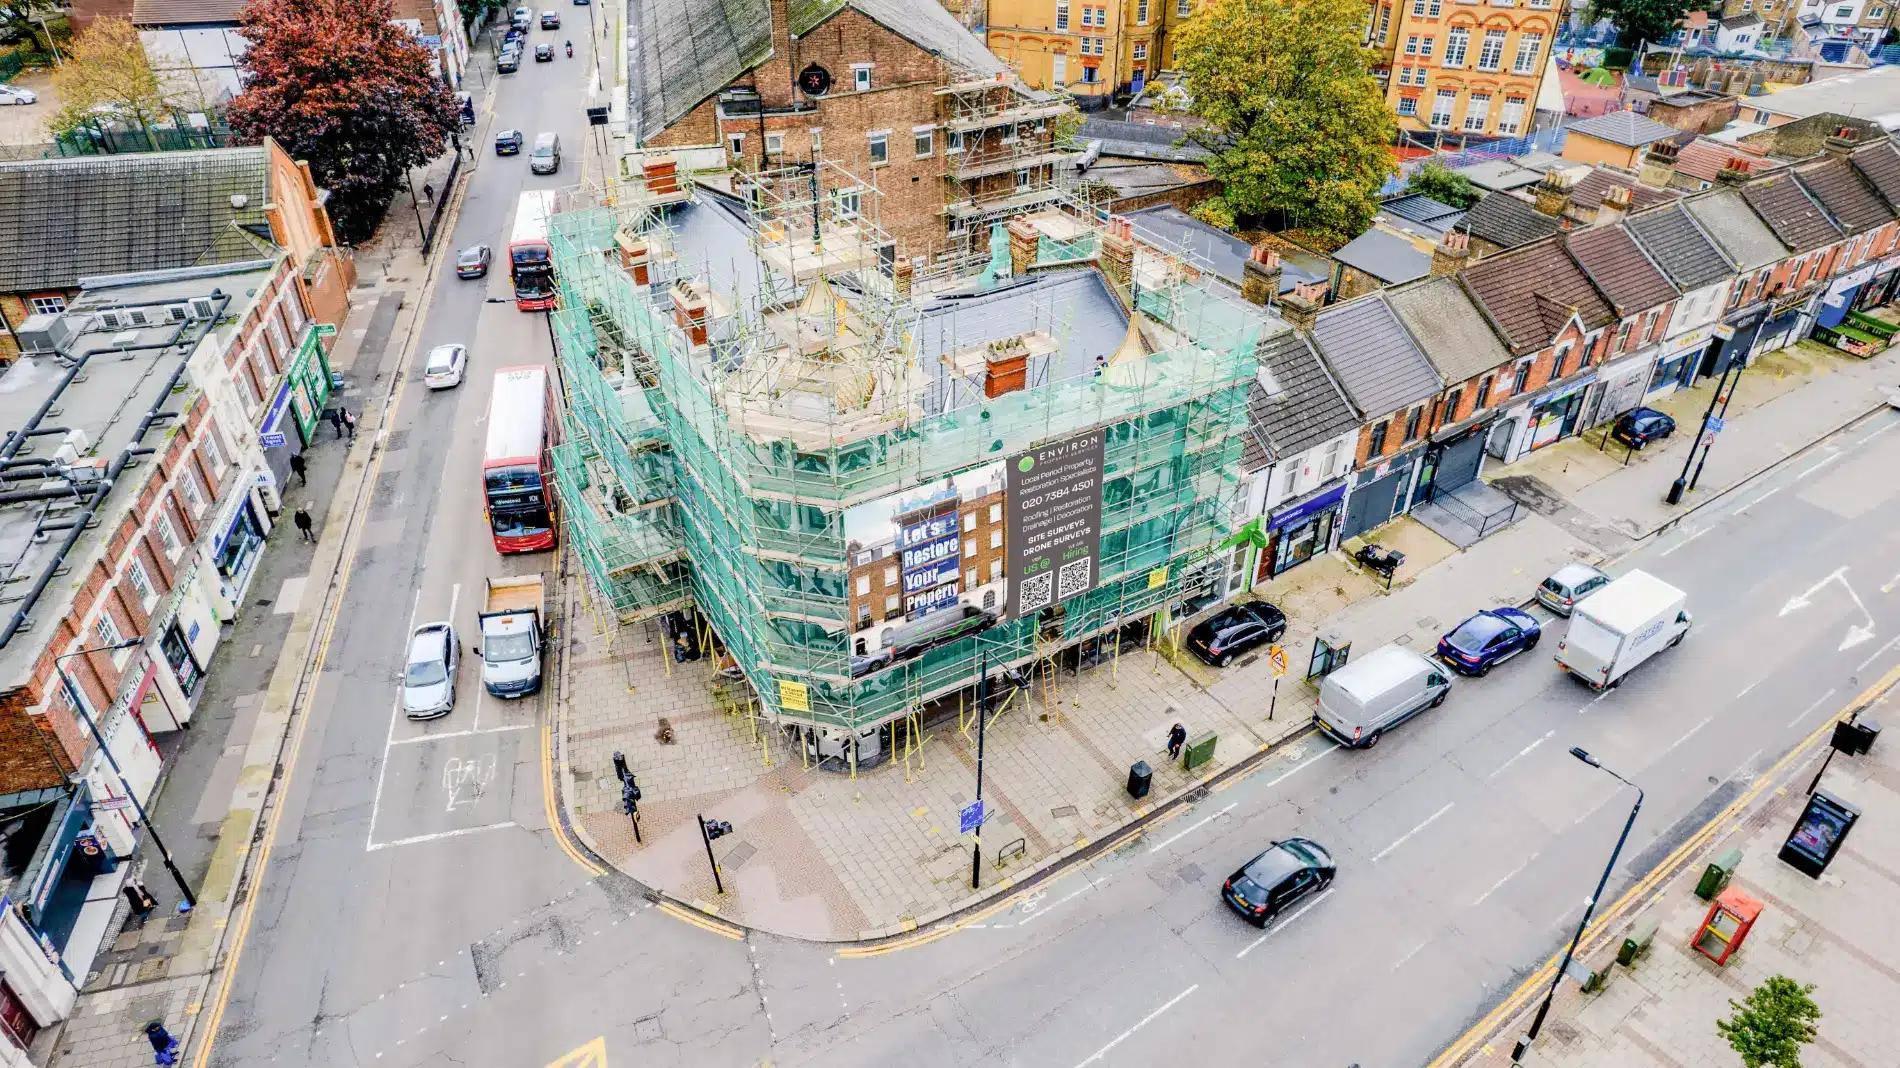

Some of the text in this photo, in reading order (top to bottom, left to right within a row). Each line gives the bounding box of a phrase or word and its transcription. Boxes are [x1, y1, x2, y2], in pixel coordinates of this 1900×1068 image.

[1039, 436, 1098, 461] ENVIRON
[1019, 466, 1097, 496] Restoration Specialists
[1021, 457, 1094, 486] Local Period Property
[1021, 478, 1094, 510] 020 7384 4501
[1022, 495, 1091, 523] Roofing Restoration
[1022, 504, 1093, 533] Drainage Decoration
[903, 521, 940, 545] Let's
[1023, 527, 1091, 557] DRONE SURVEYS
[1027, 518, 1085, 544] SITE SURVEYS
[904, 538, 958, 567] Restore
[1062, 545, 1089, 560] Hiring
[905, 567, 938, 591] Your
[906, 582, 959, 612] Property
